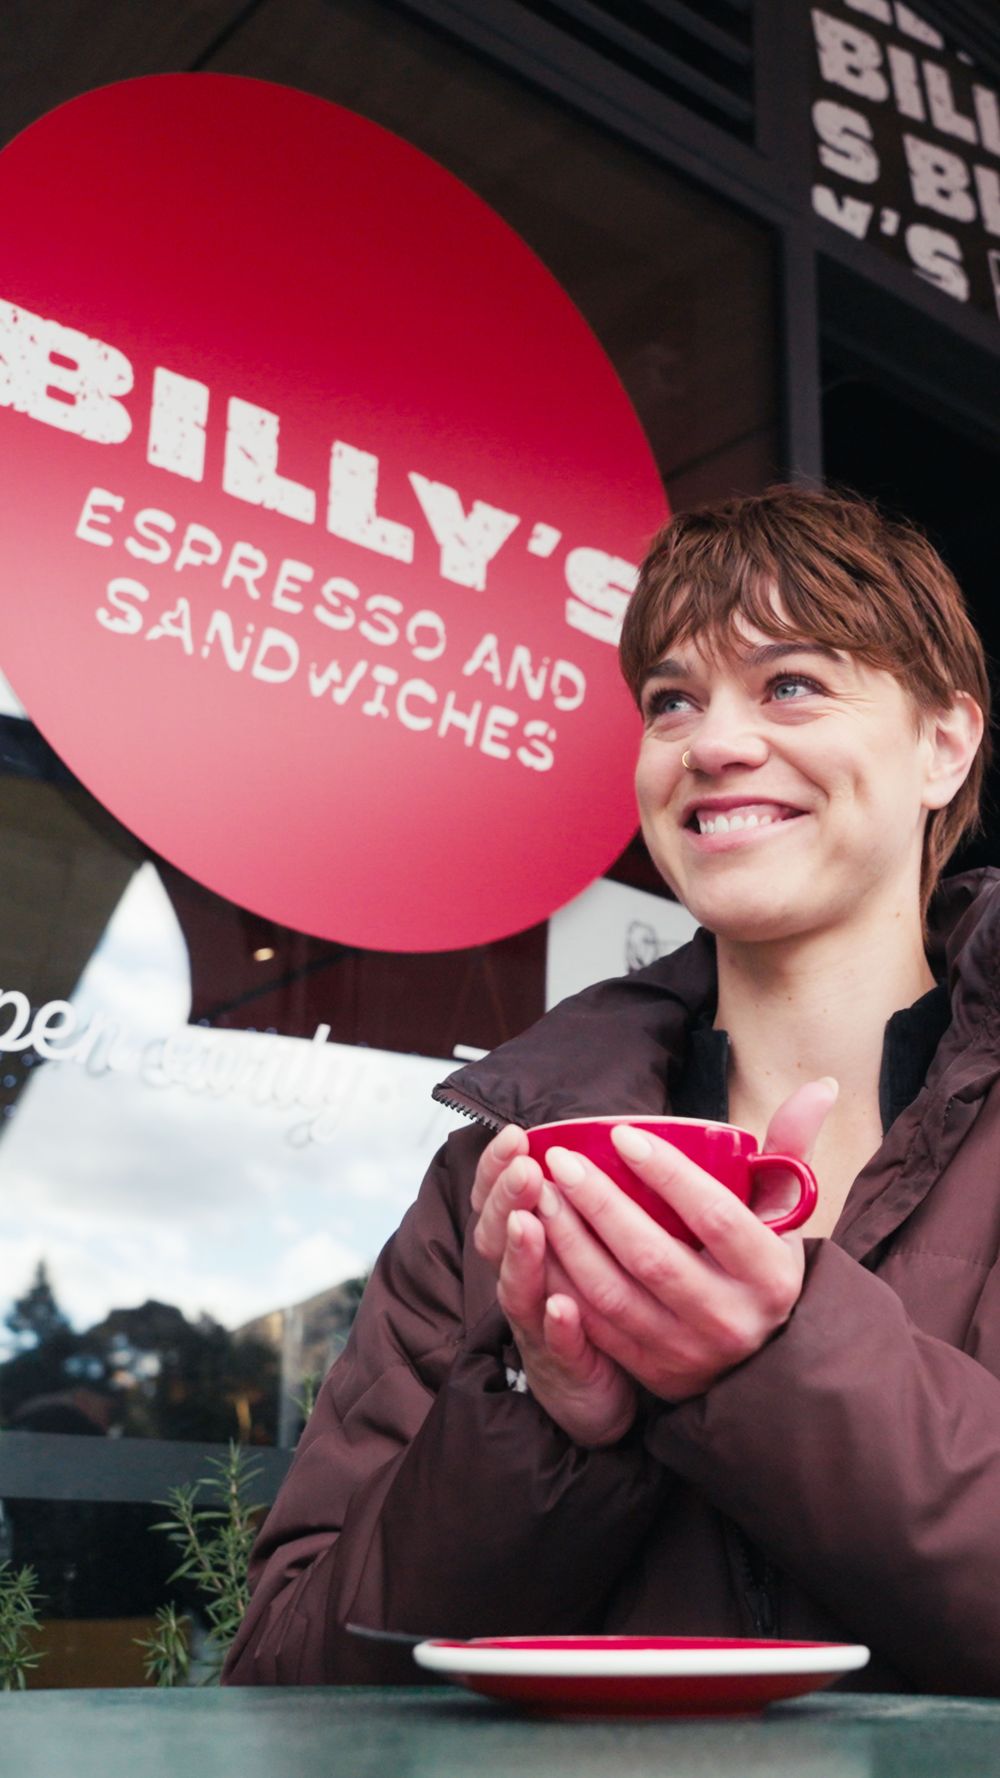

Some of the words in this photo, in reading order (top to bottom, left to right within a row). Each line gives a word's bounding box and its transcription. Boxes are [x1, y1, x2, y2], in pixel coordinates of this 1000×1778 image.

[0, 298, 641, 648] BILLY'S
[75, 487, 446, 661] ESPRESSO
[463, 633, 586, 711] AND
[96, 577, 557, 771] SANDWICHES
